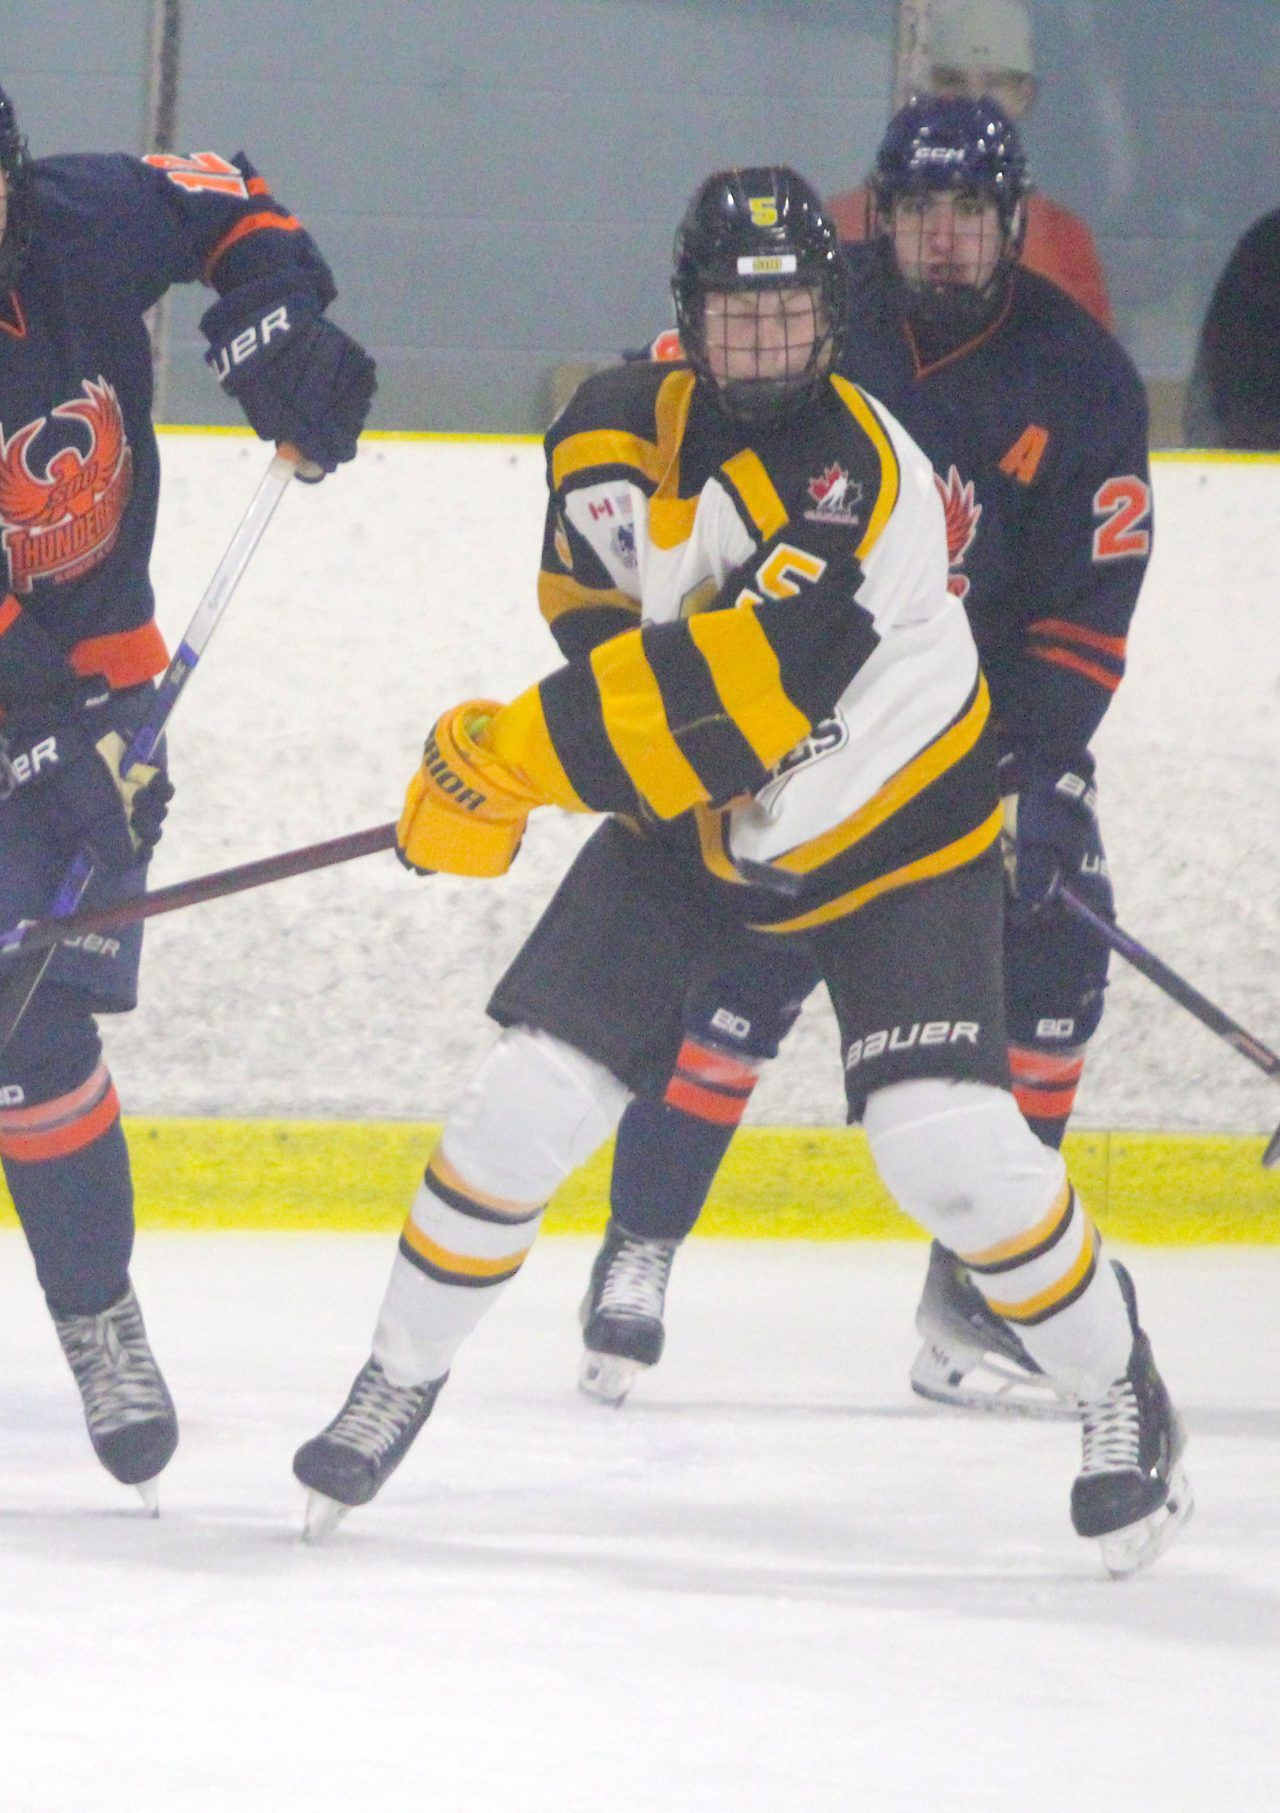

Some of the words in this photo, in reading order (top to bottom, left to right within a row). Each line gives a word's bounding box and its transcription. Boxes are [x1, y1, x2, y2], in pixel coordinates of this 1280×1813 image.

[748, 196, 779, 228] 5
[998, 423, 1050, 485] A
[1092, 475, 1151, 563] 2
[846, 1020, 980, 1071] BAUER
